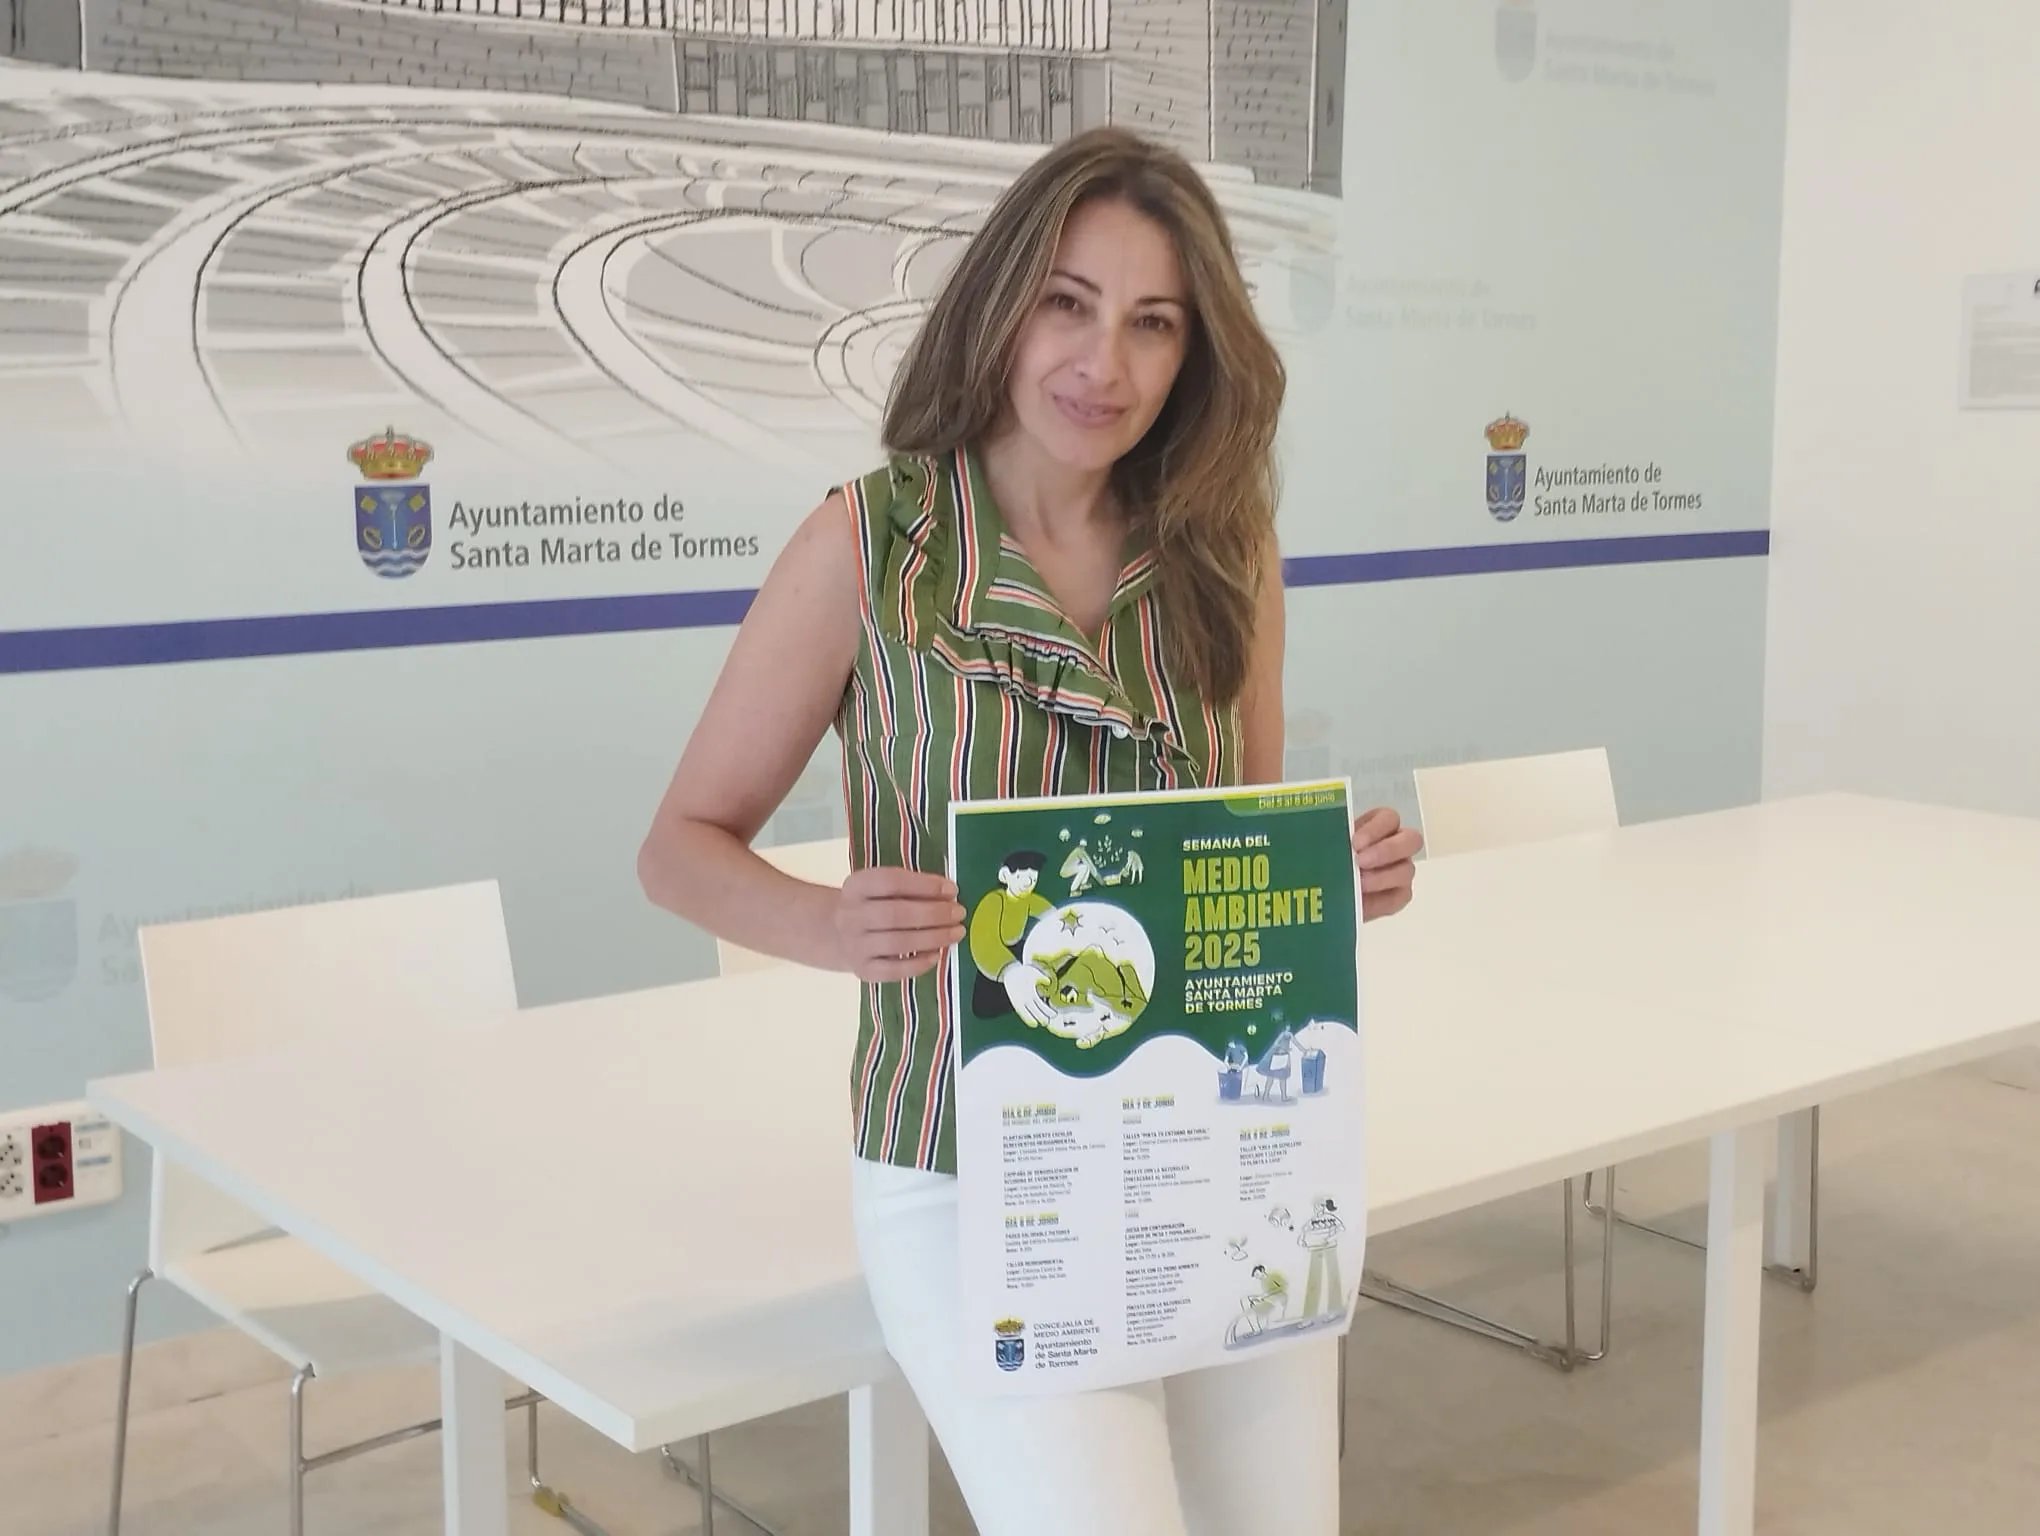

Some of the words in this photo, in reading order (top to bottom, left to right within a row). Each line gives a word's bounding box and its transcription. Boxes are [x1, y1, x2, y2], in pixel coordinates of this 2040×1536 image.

[1535, 464, 1640, 491] Ayuntamiento
[1644, 462, 1662, 485] de
[1535, 493, 1577, 517] Santa
[1582, 492, 1626, 515] Marta
[1630, 490, 1649, 512] de
[1652, 490, 1702, 512] Tormes
[449, 496, 644, 536] Ayuntamiento
[653, 493, 685, 522] de
[450, 539, 530, 570] Santa
[540, 535, 621, 566] Marta
[631, 533, 662, 562] de
[669, 532, 759, 560] Tormes
[1183, 837, 1241, 851] SEMANA
[1245, 834, 1270, 848] DEL
[1183, 855, 1270, 895] MEDIO
[1184, 887, 1323, 933] AMBIENTE
[1184, 932, 1261, 971] 2025
[1184, 971, 1293, 990] AYUNTAMIENTO
[1185, 988, 1231, 1002] SANTA
[1234, 985, 1283, 999] MARTA
[1185, 1000, 1203, 1014] DE
[1207, 998, 1263, 1012] TORMES
[1084, 1317, 1094, 1326] DE
[1033, 1330, 1060, 1339] MEDIO
[1061, 1326, 1100, 1336] AMBIENTE
[1034, 1338, 1092, 1351] Ayuntamiento
[1034, 1351, 1045, 1360] de
[1047, 1350, 1072, 1359] Santa
[1073, 1347, 1098, 1356] Marta
[1034, 1362, 1046, 1370] de
[1048, 1359, 1079, 1369] Tormes
